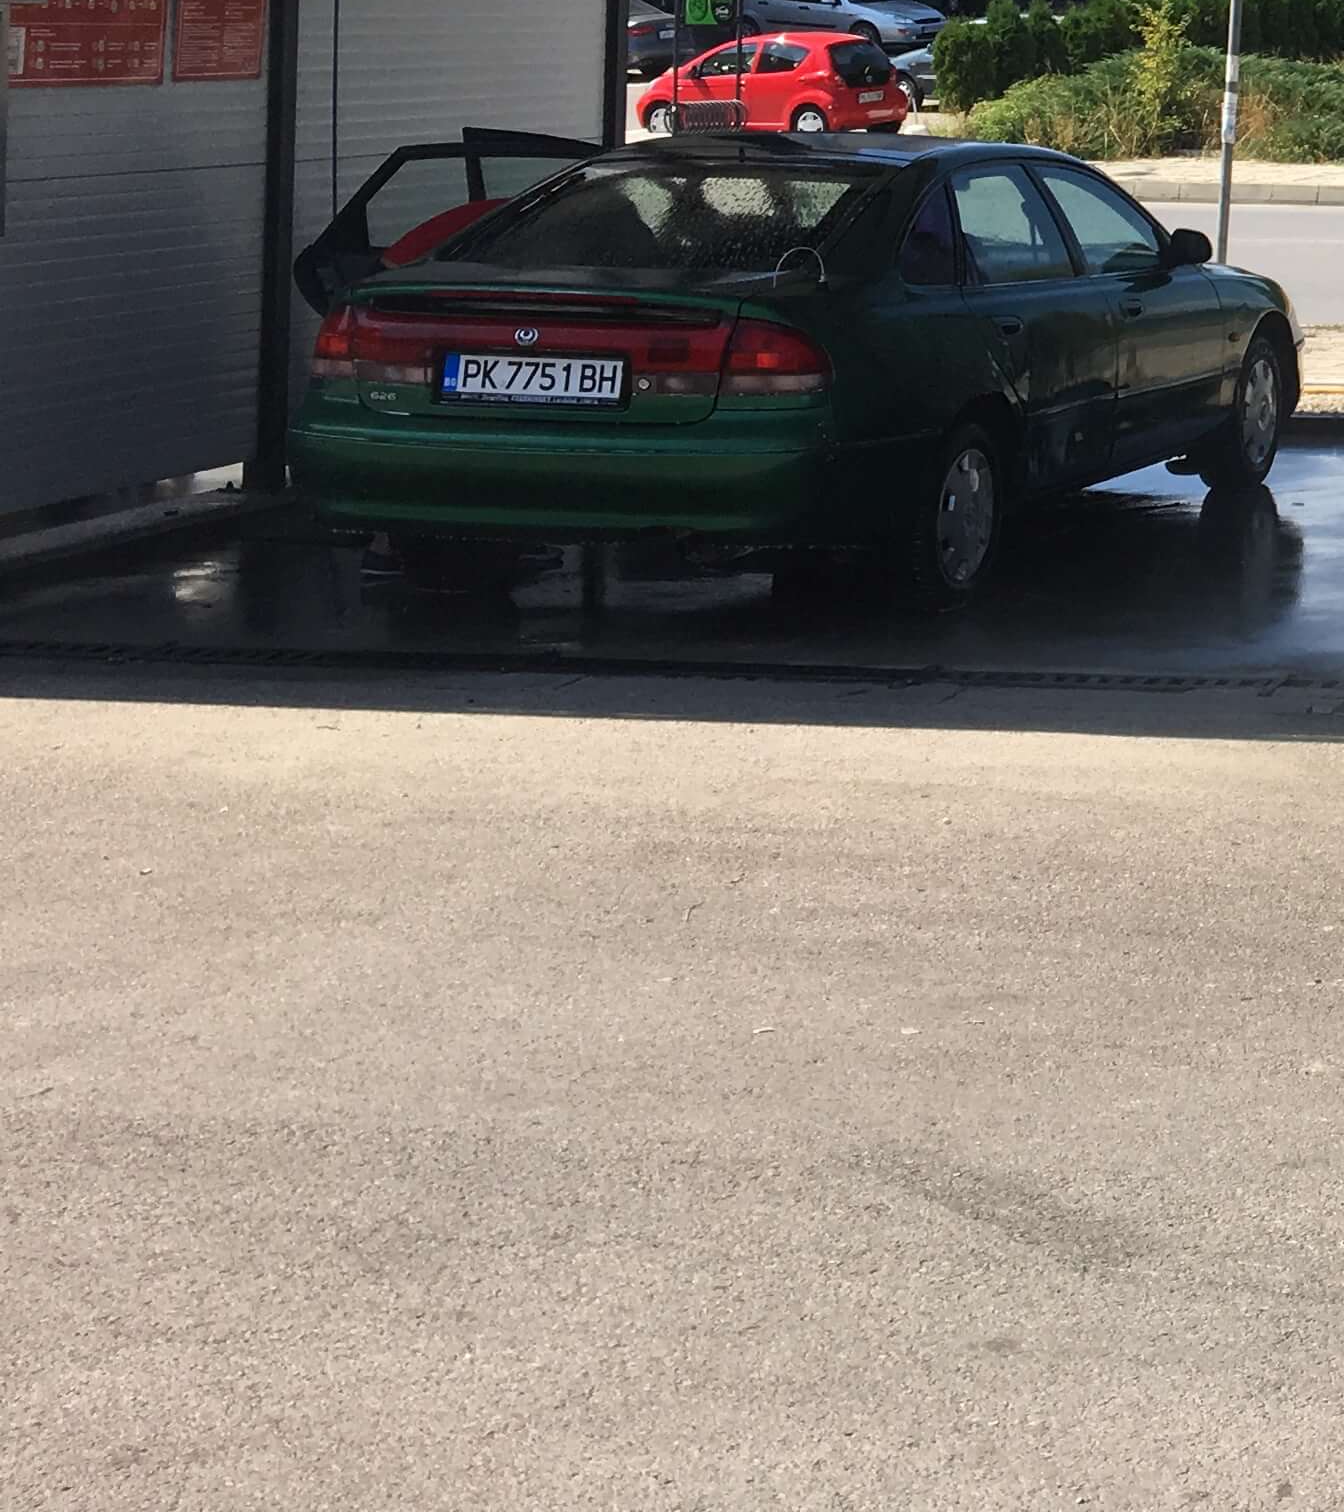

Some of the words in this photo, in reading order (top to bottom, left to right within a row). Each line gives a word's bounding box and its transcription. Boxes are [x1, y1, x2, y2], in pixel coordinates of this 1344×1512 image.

[462, 359, 499, 390] PK
[505, 361, 573, 393] 7751
[578, 364, 618, 395] BH
